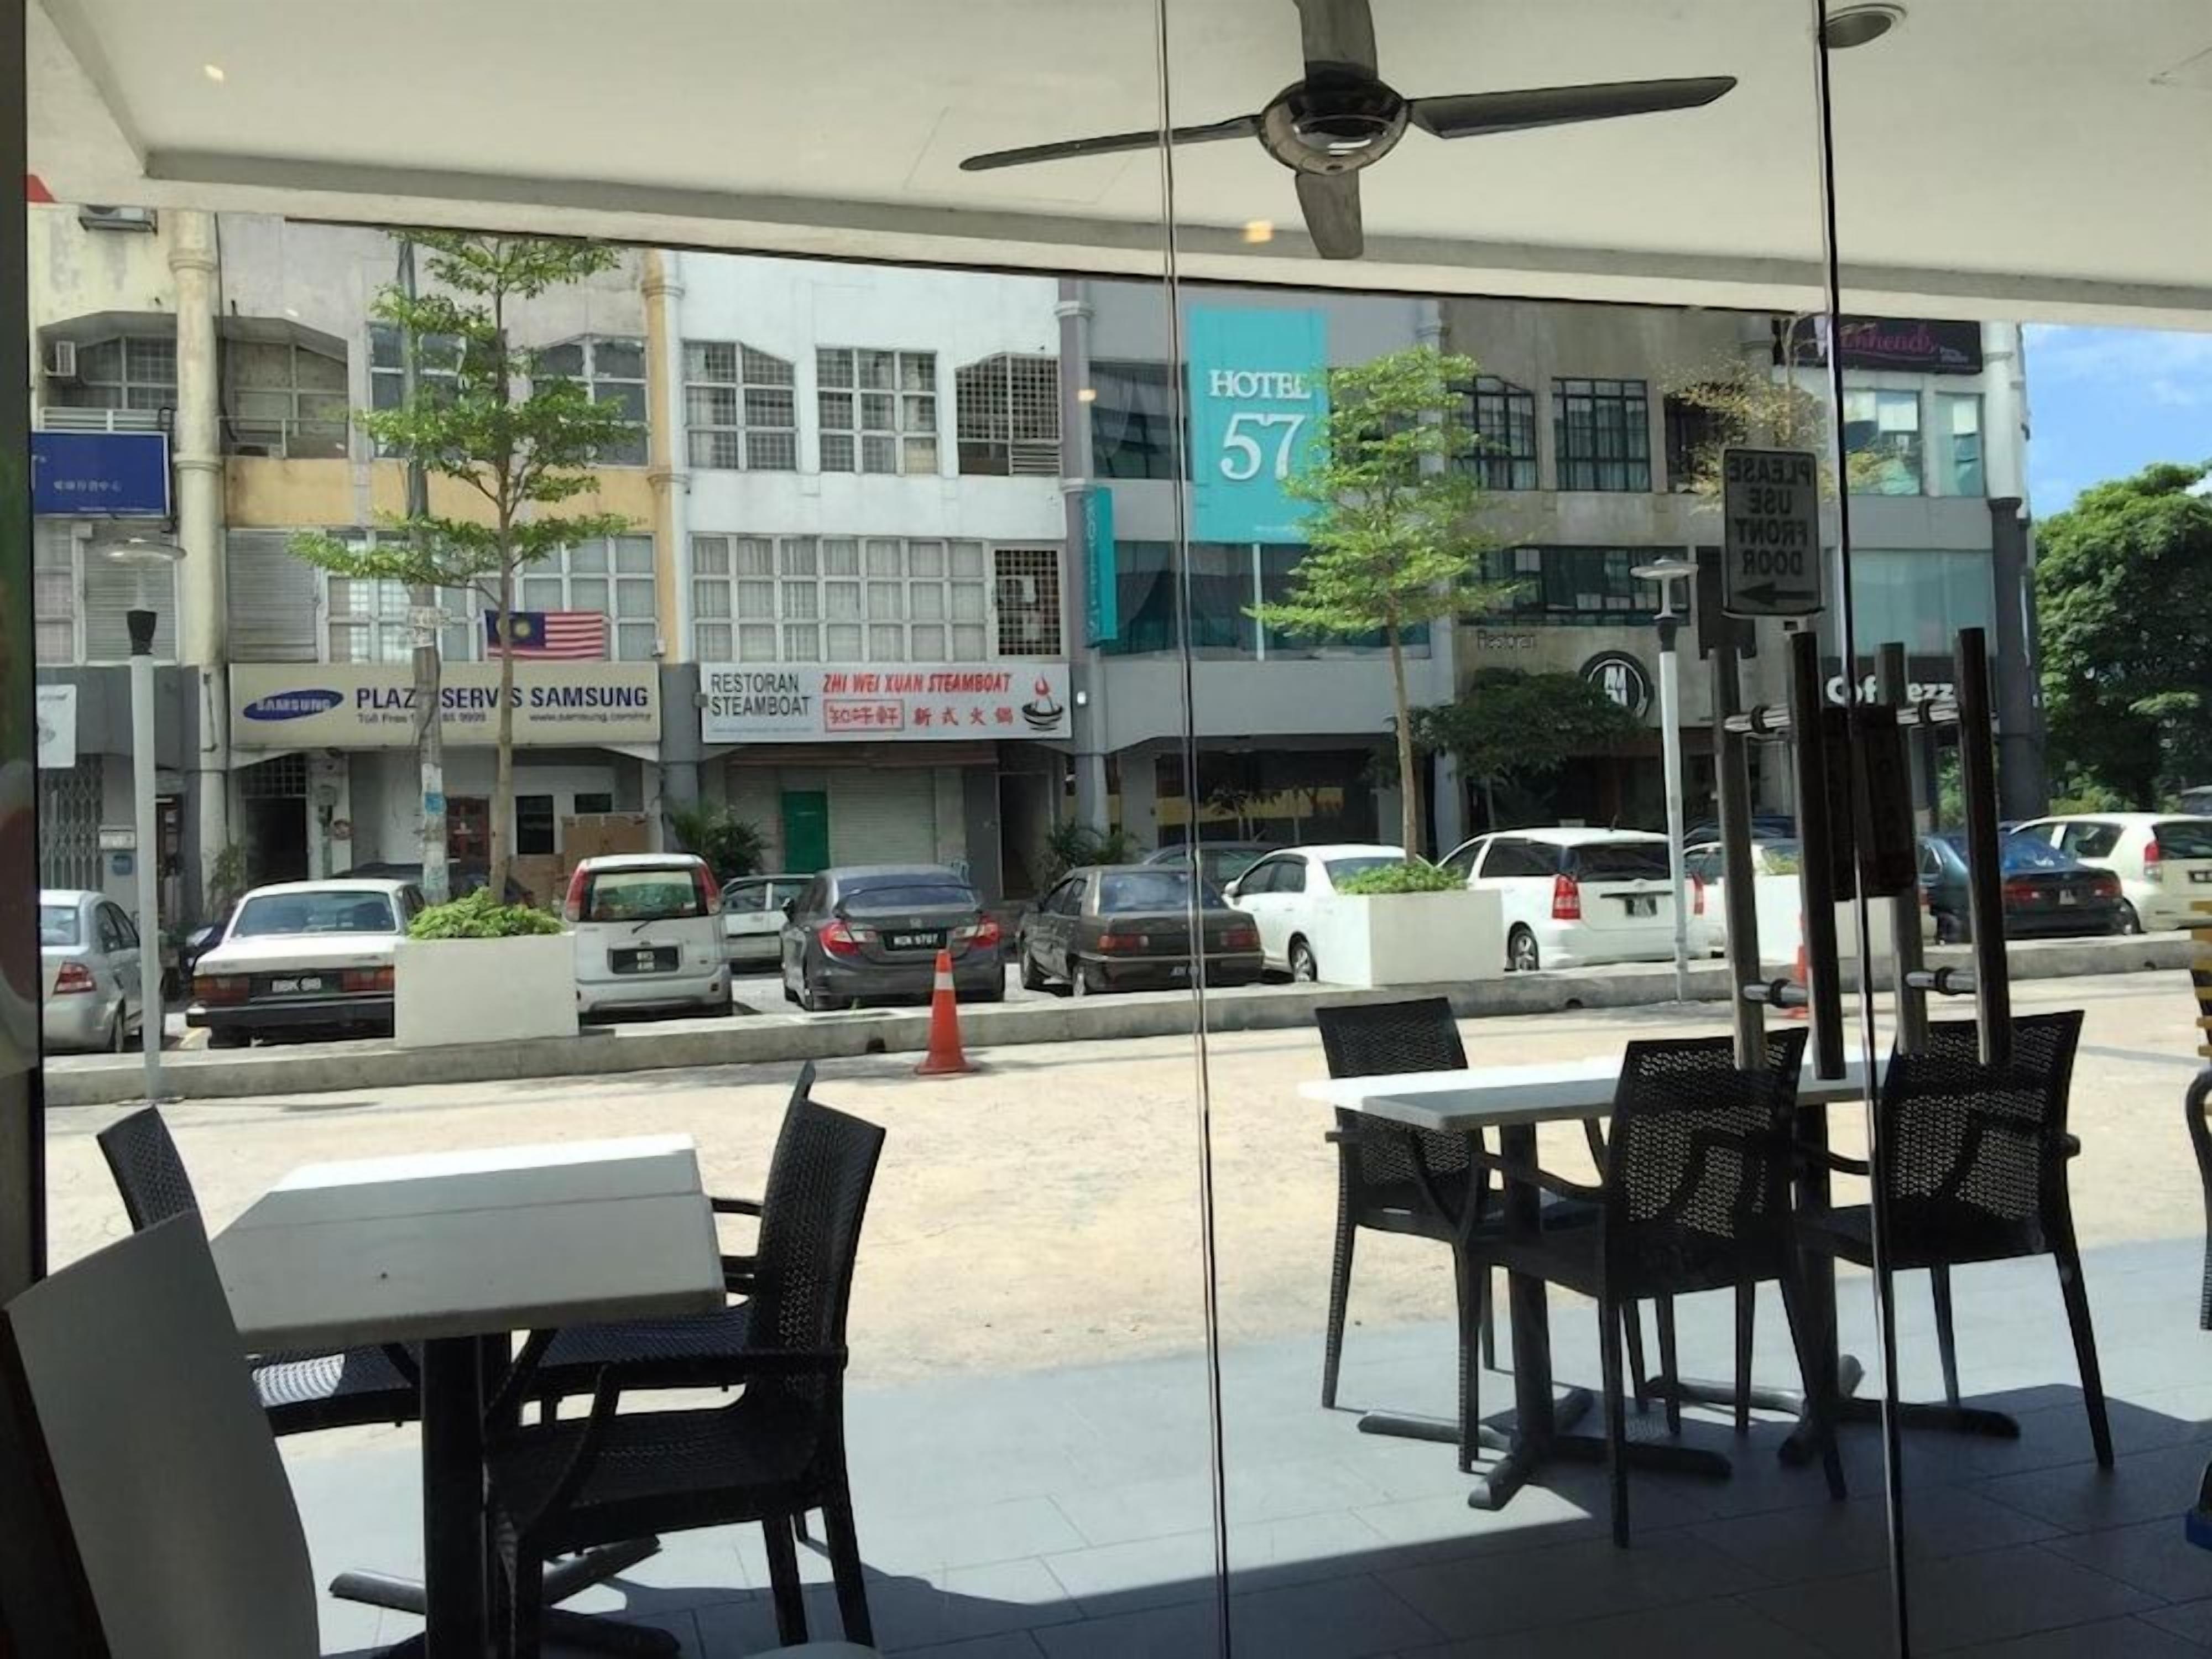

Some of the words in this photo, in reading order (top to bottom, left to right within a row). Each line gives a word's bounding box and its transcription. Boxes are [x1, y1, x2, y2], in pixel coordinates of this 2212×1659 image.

[1209, 369, 1312, 399] HOTEL
[1220, 413, 1305, 480] 57
[711, 672, 800, 692] RESTORAN
[823, 674, 847, 692] ZHI
[853, 674, 881, 692] WEI
[885, 674, 923, 692] XUAN
[927, 673, 1012, 692] STEAMBOAT
[255, 698, 331, 712] SAMSUNG
[357, 688, 419, 708] PLAZ
[442, 687, 522, 708] SERVS
[530, 687, 648, 707] SAMSUNG
[712, 696, 811, 716] STEAMBOAT
